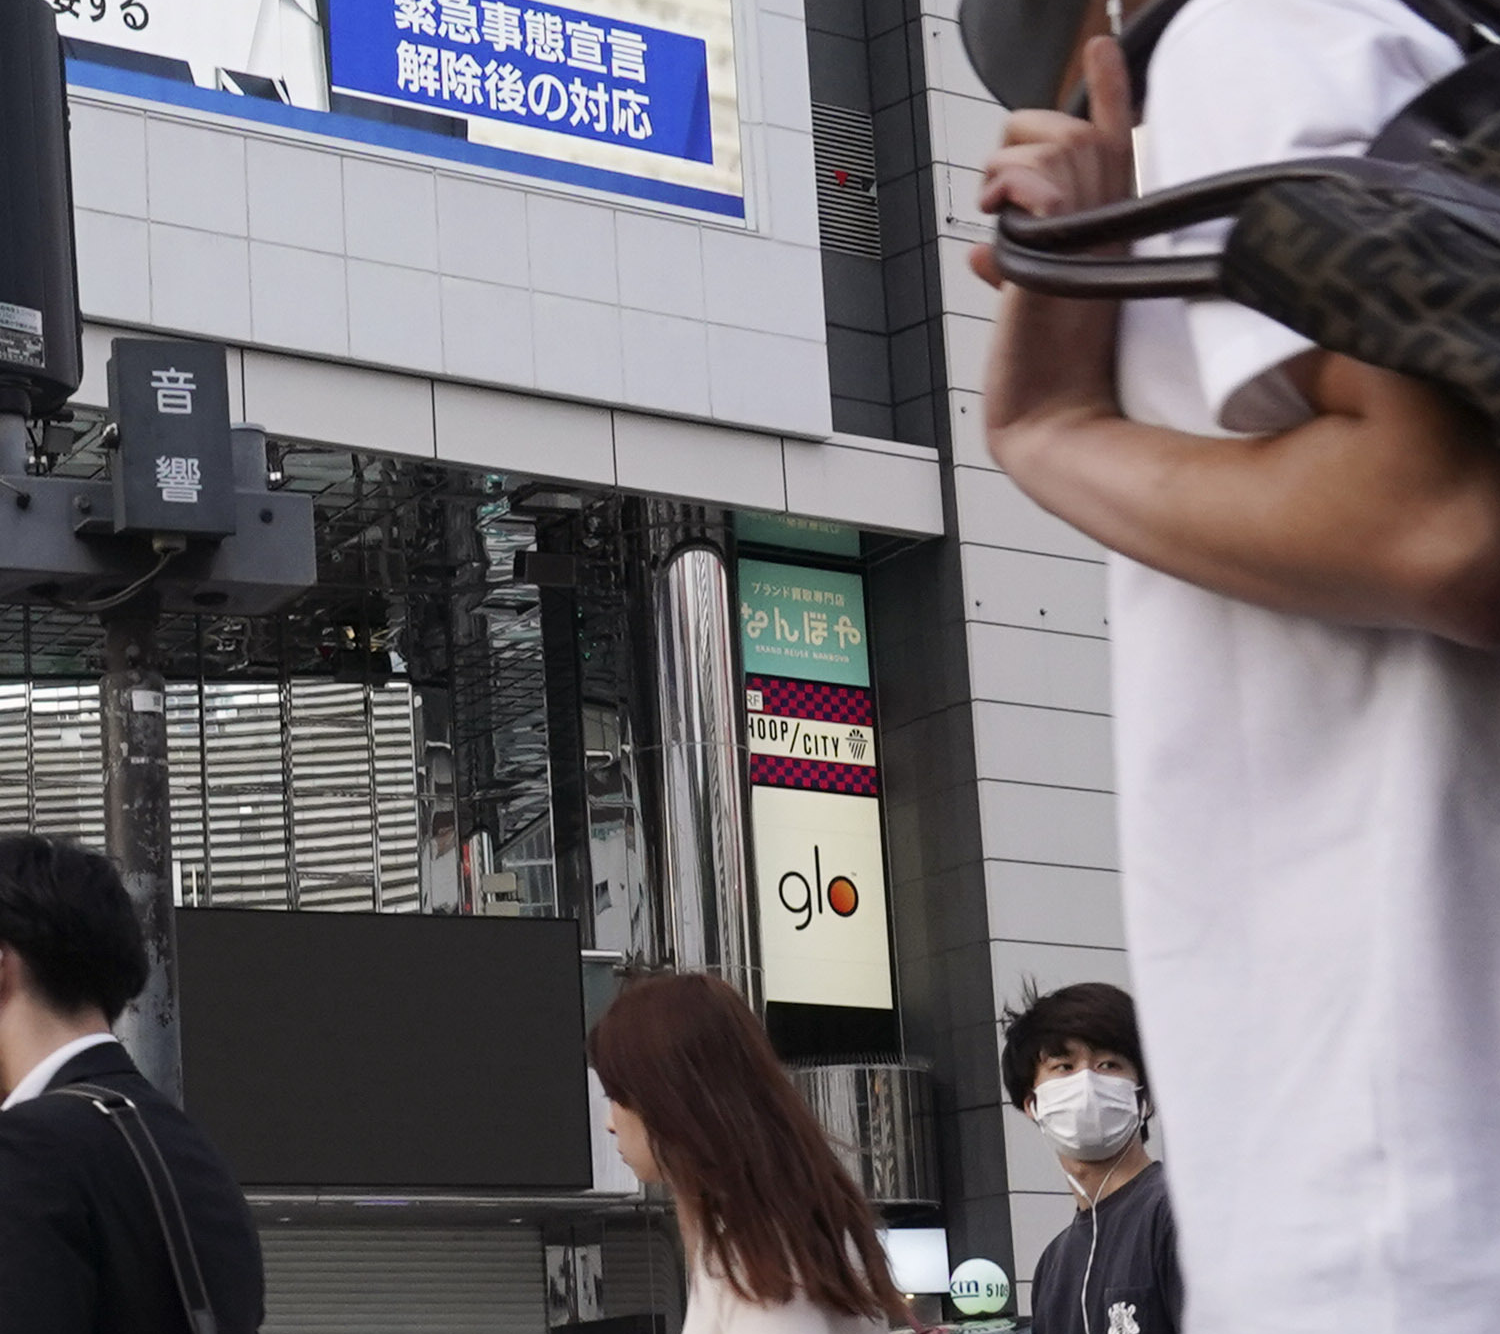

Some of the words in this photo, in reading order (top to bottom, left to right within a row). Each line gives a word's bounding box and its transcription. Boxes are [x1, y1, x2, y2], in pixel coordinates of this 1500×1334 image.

[397, 39, 653, 140] 解除後の対応
[151, 367, 202, 503] 音響
[741, 601, 861, 649] なんぼや
[778, 844, 859, 931] glo
